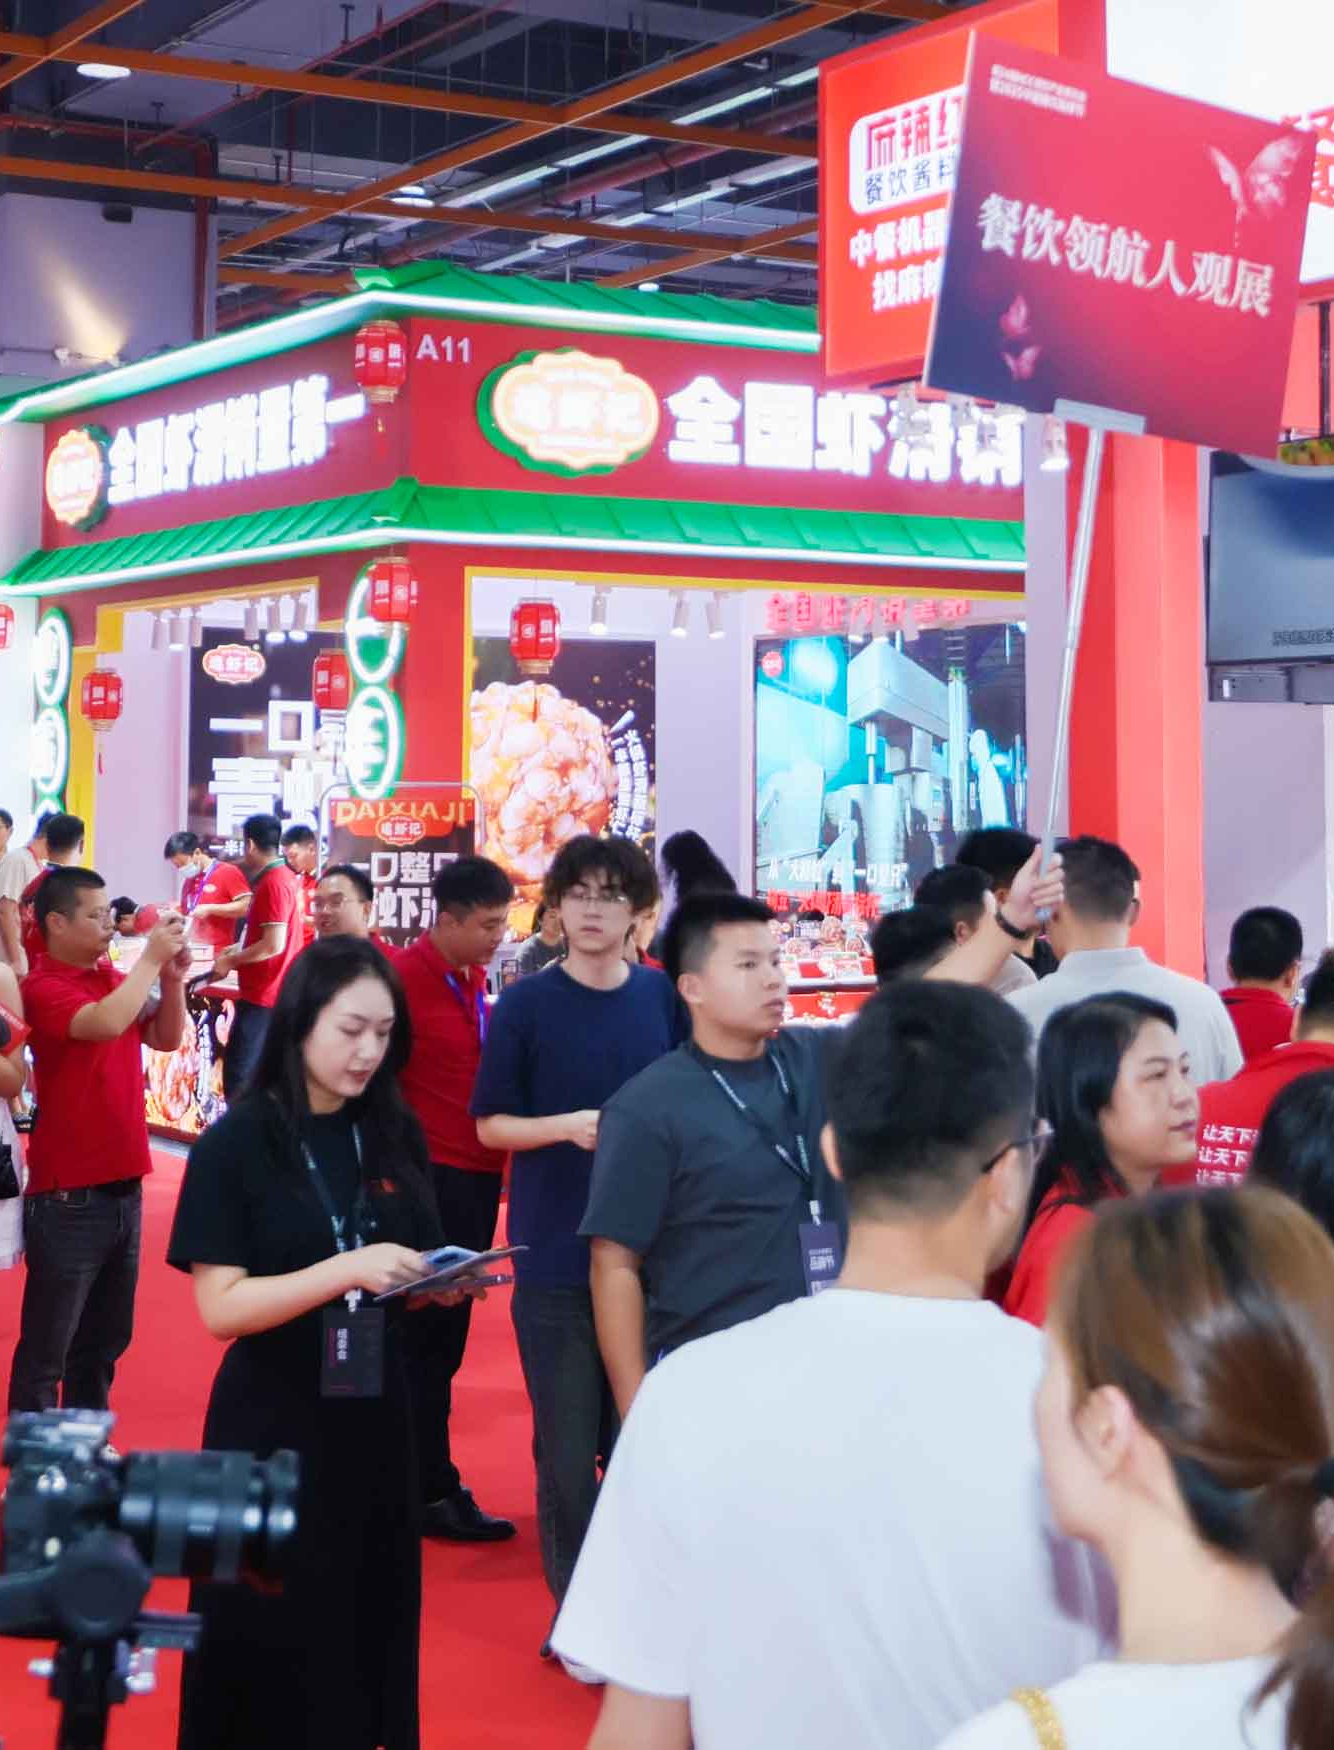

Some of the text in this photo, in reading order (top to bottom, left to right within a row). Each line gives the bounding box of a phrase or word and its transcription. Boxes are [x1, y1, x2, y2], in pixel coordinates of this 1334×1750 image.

[978, 193, 1275, 317] 餐饮领航人观展
[416, 334, 471, 363] A11
[335, 801, 467, 828] DAIXIAJI
[1198, 1146, 1248, 1168] 让天下
